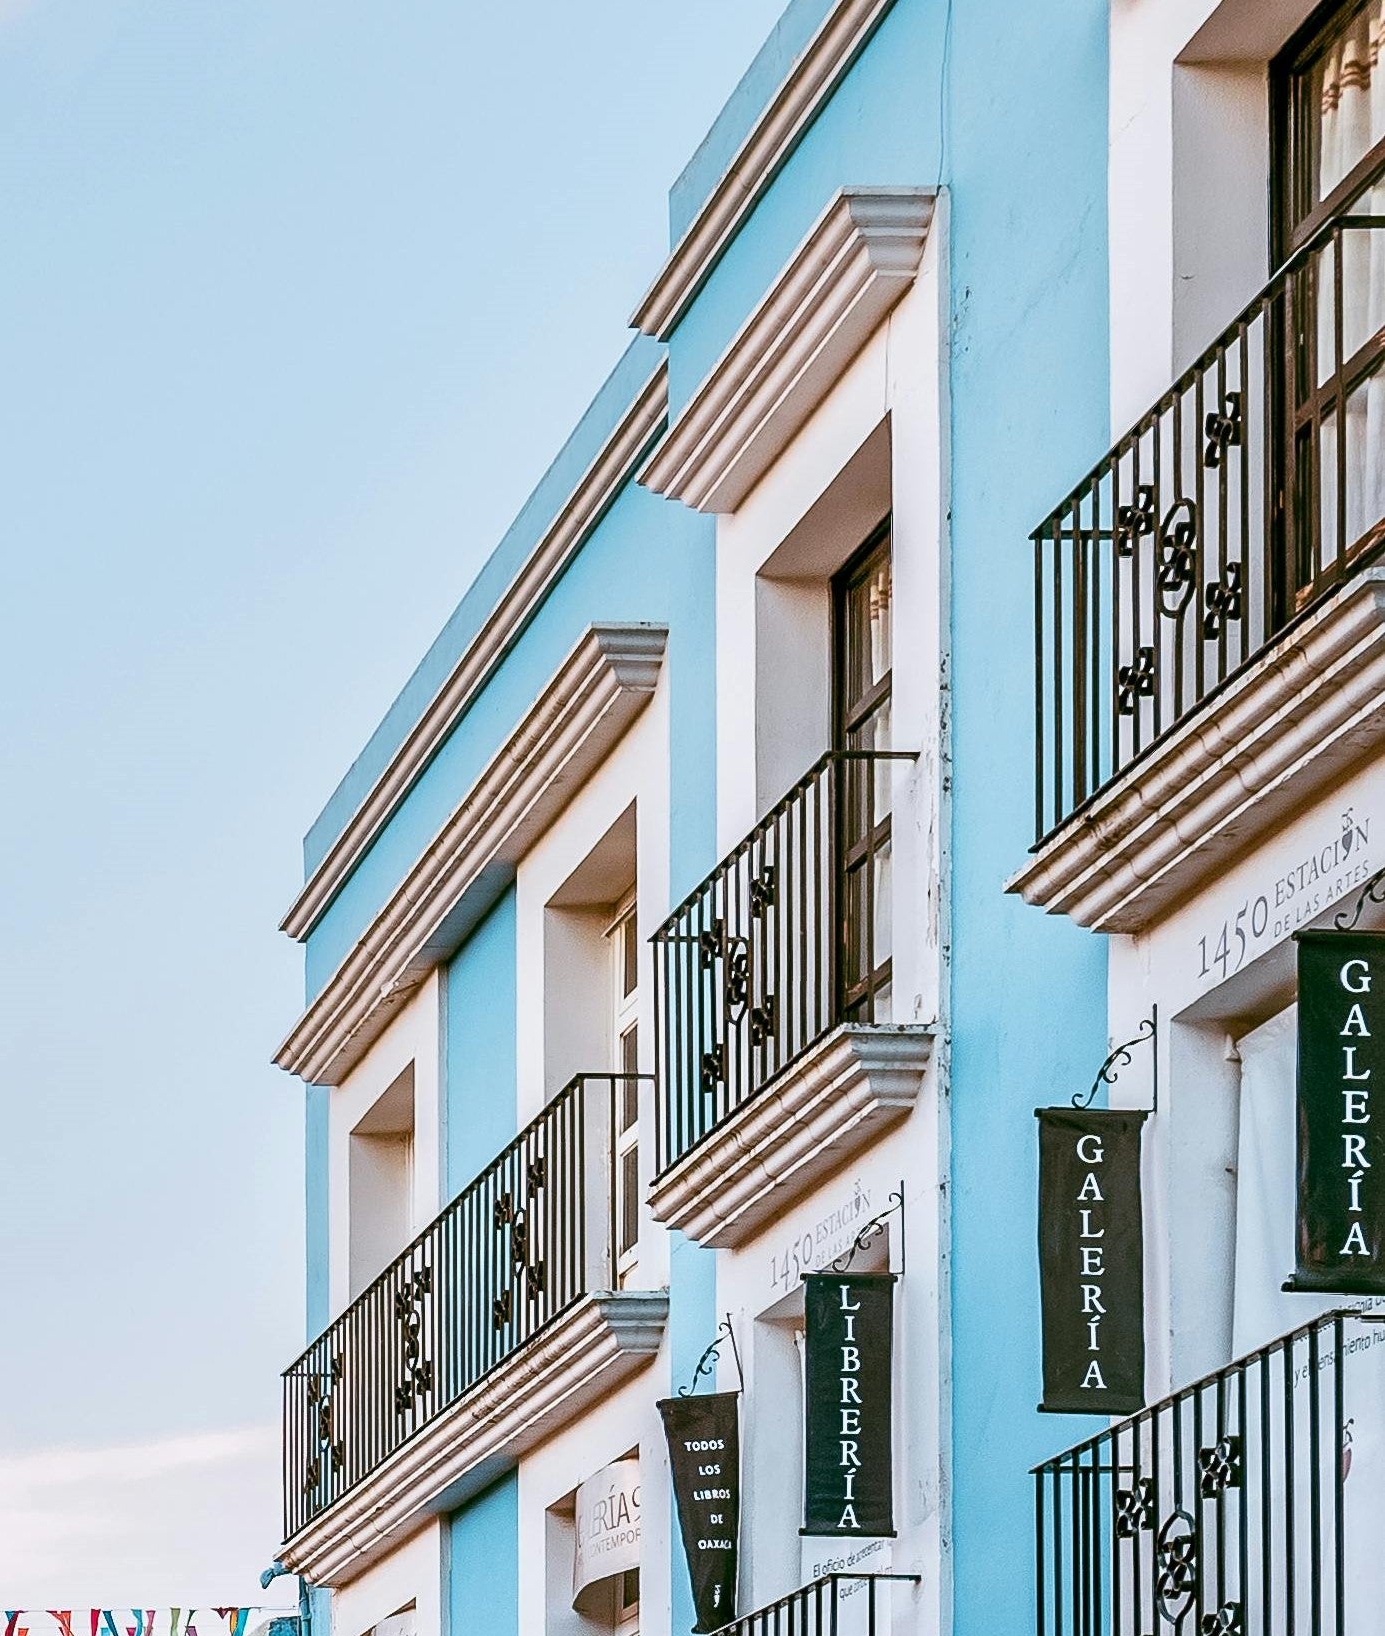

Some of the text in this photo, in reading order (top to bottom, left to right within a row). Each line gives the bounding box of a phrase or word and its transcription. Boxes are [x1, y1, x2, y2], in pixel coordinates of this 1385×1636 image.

[1274, 859, 1370, 938] DE LAS ARTES
[1197, 896, 1268, 979] 1450
[1339, 959, 1372, 1257] GALERÍA
[770, 1233, 813, 1291] 1450
[1076, 1134, 1108, 1389] GALERÍA
[836, 1284, 863, 1529] LIBRERÍA
[684, 1439, 725, 1452] TODOS
[698, 1464, 721, 1476] LOS
[693, 1489, 731, 1501] LIBROS
[710, 1514, 724, 1525] DE
